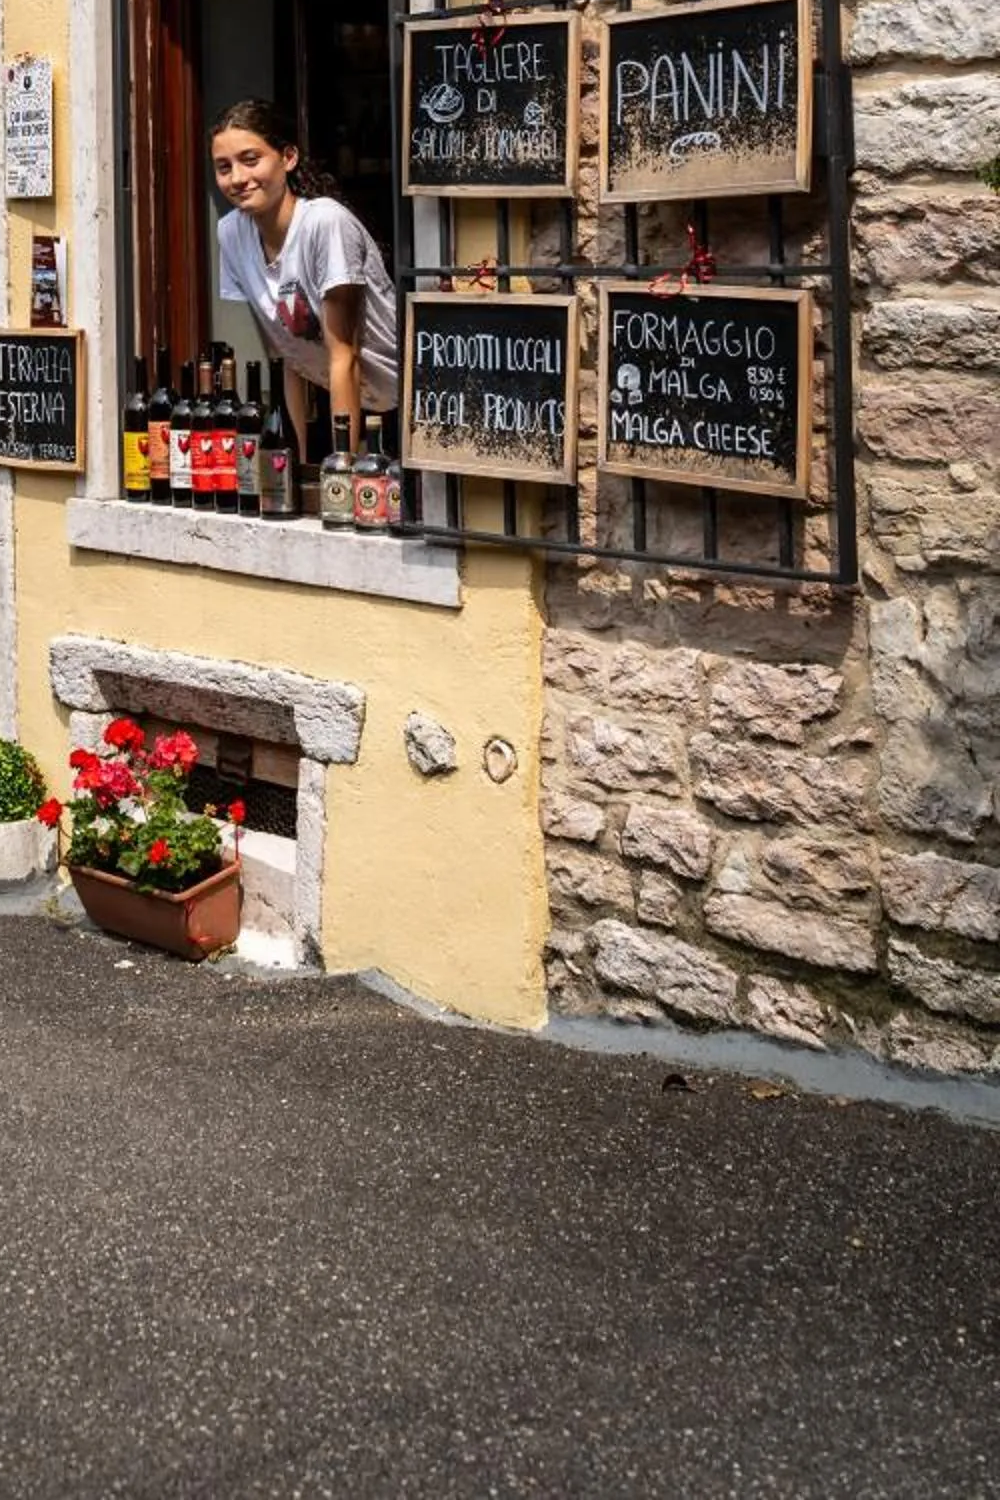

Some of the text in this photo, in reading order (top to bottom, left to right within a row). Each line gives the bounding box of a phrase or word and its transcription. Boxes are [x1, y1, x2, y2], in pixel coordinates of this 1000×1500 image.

[434, 41, 546, 83] TAGLIERE
[477, 88, 498, 113] DI
[417, 331, 561, 374] PRODOTTI LOCALI
[613, 309, 775, 360] FORMAGGIO
[648, 361, 733, 402] MALGA
[680, 356, 696, 368] DI
[777, 367, 788, 385] €
[414, 389, 565, 437] LOCAL PRODUCTS
[611, 409, 776, 456] MALGA CHEESE
